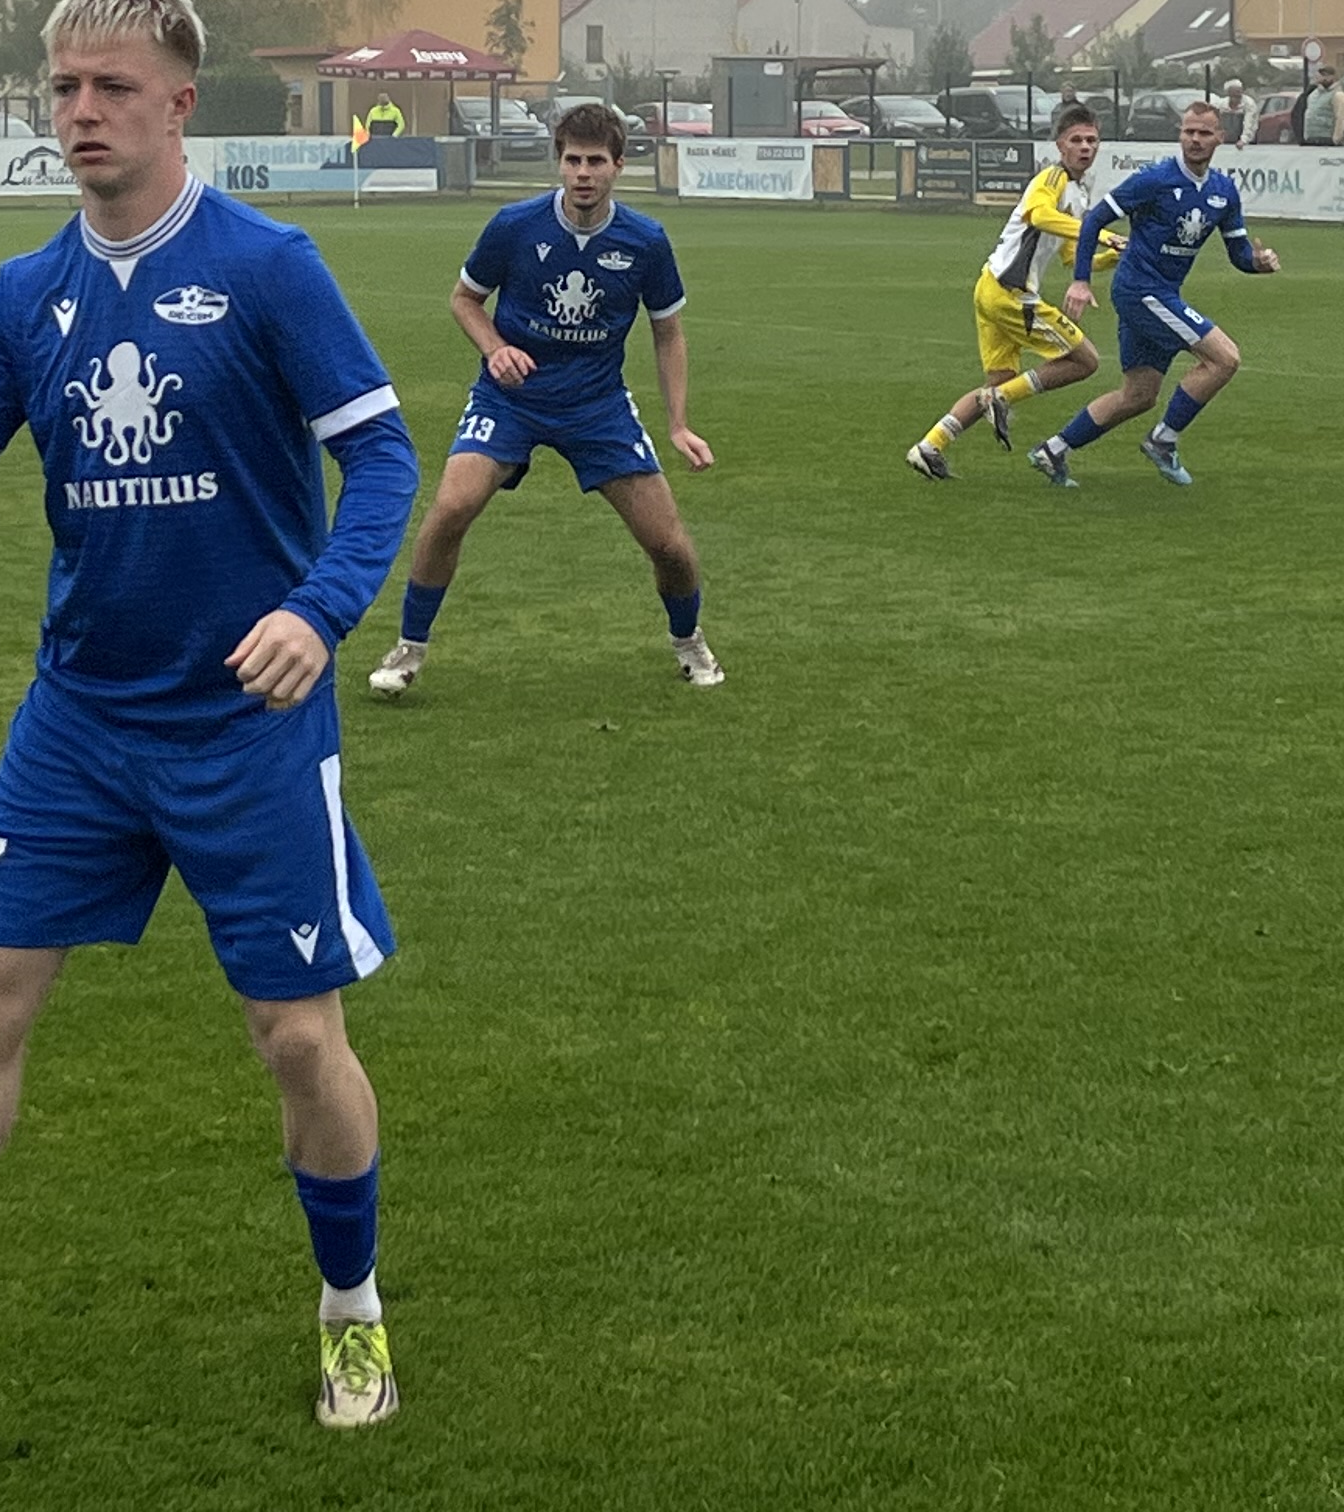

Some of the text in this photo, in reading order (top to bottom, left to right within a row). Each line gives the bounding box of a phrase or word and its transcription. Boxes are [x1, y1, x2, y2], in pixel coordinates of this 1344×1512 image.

[227, 165, 270, 190] KOS
[1218, 167, 1304, 195] XOBAL
[529, 319, 608, 342] NAUTILUS
[459, 415, 496, 443] 13
[63, 471, 219, 510] NAUTILUS
